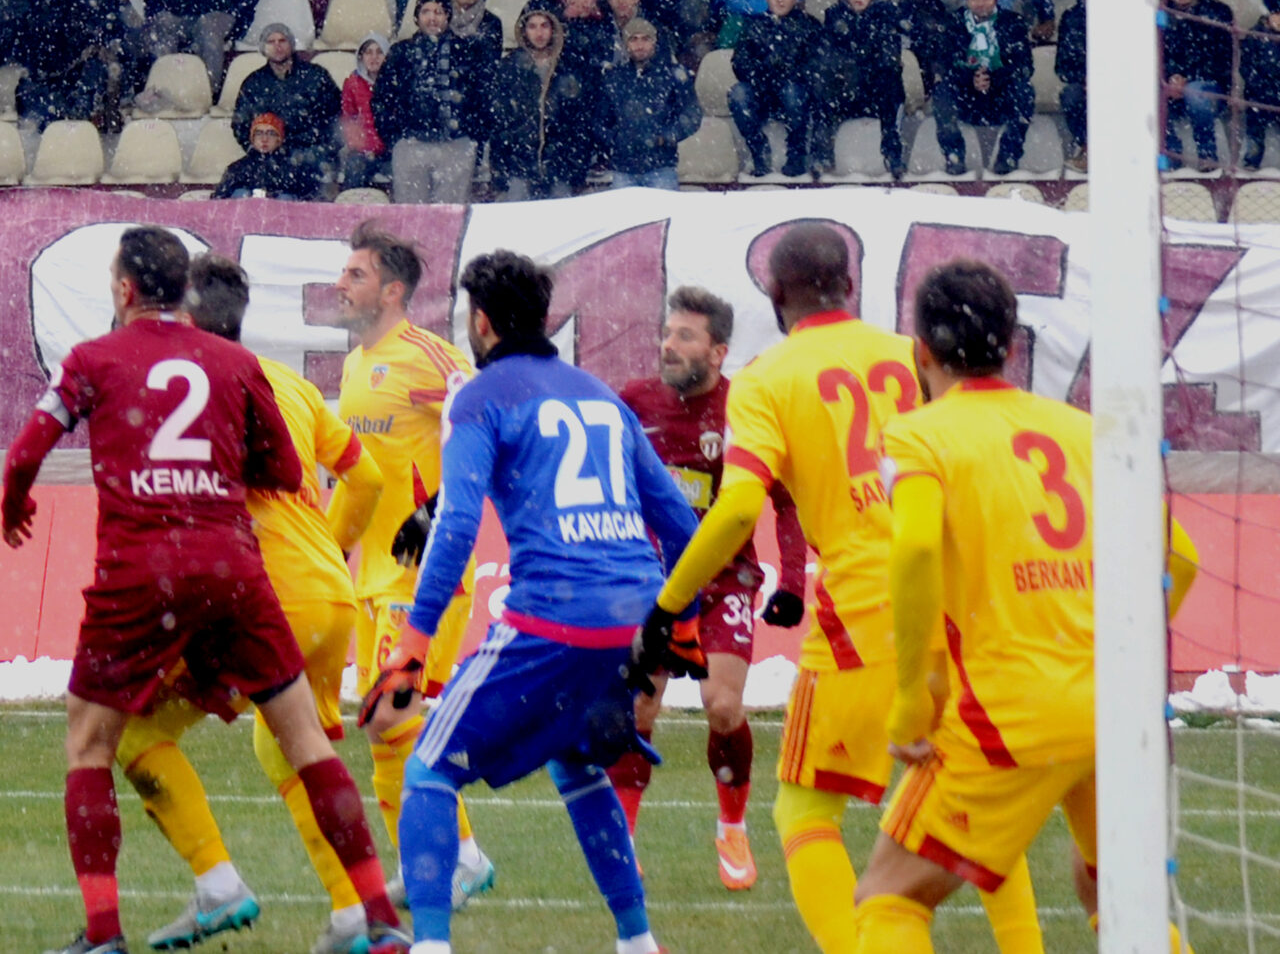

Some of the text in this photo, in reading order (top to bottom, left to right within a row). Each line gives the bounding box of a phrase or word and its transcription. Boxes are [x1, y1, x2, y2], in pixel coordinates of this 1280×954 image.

[147, 359, 211, 461] 2
[538, 399, 627, 509] 27
[130, 468, 229, 496] KEMAL
[1012, 429, 1086, 551] 3
[1013, 559, 1087, 593] BERKAN
